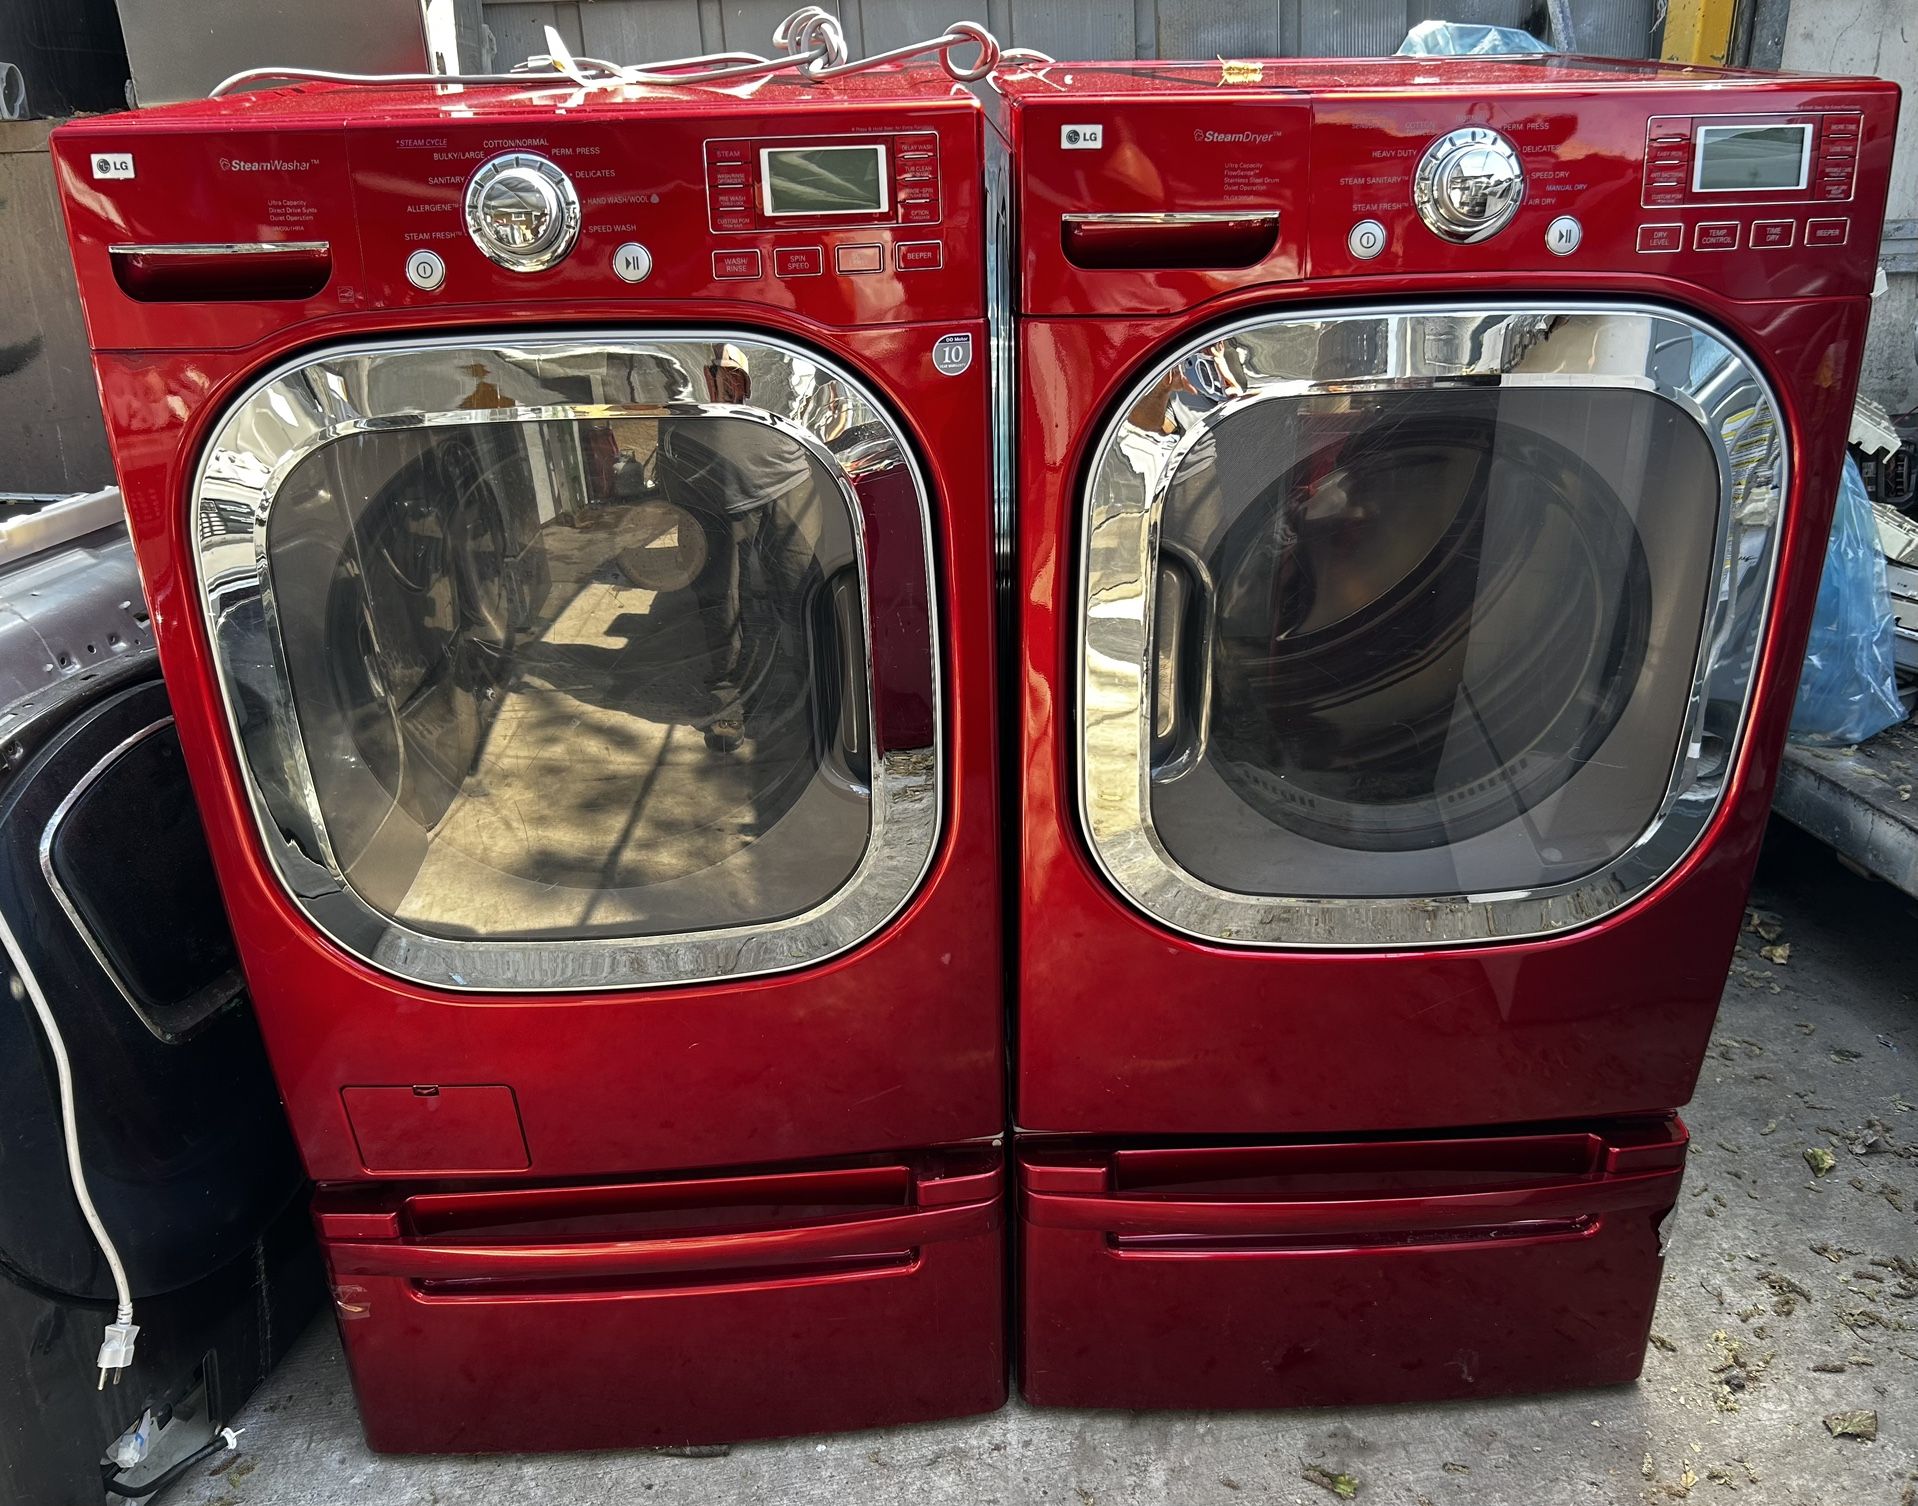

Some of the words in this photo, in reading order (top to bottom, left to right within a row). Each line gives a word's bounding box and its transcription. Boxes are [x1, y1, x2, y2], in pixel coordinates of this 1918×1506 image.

[1526, 122, 1549, 130] PRESS
[1083, 132, 1098, 142] LG
[425, 138, 447, 146] CYCLE
[483, 138, 549, 148] COTTON/NORMAL
[576, 146, 600, 155] PRESS
[716, 150, 740, 158] STEAM
[1397, 149, 1417, 157] DUTY
[433, 151, 485, 161] BULKY/LARGE
[113, 160, 129, 171] LG
[575, 169, 616, 178] DELICATES
[1531, 171, 1554, 179] SPEED
[428, 176, 465, 185] SANITARY
[1340, 177, 1365, 186] STEAM
[587, 197, 606, 205] HAND
[606, 195, 649, 204] WASH/WOOL
[1528, 198, 1541, 206] AIR
[1352, 203, 1378, 212] STEAM
[588, 225, 612, 233] SPEED
[613, 224, 637, 232] WASH
[404, 232, 430, 241] STEAM
[1702, 236, 1733, 244] CONTROL
[907, 251, 932, 259] BEEPER
[726, 264, 747, 272] RINSE
[787, 262, 809, 270] SPEED
[943, 345, 964, 363] 10
